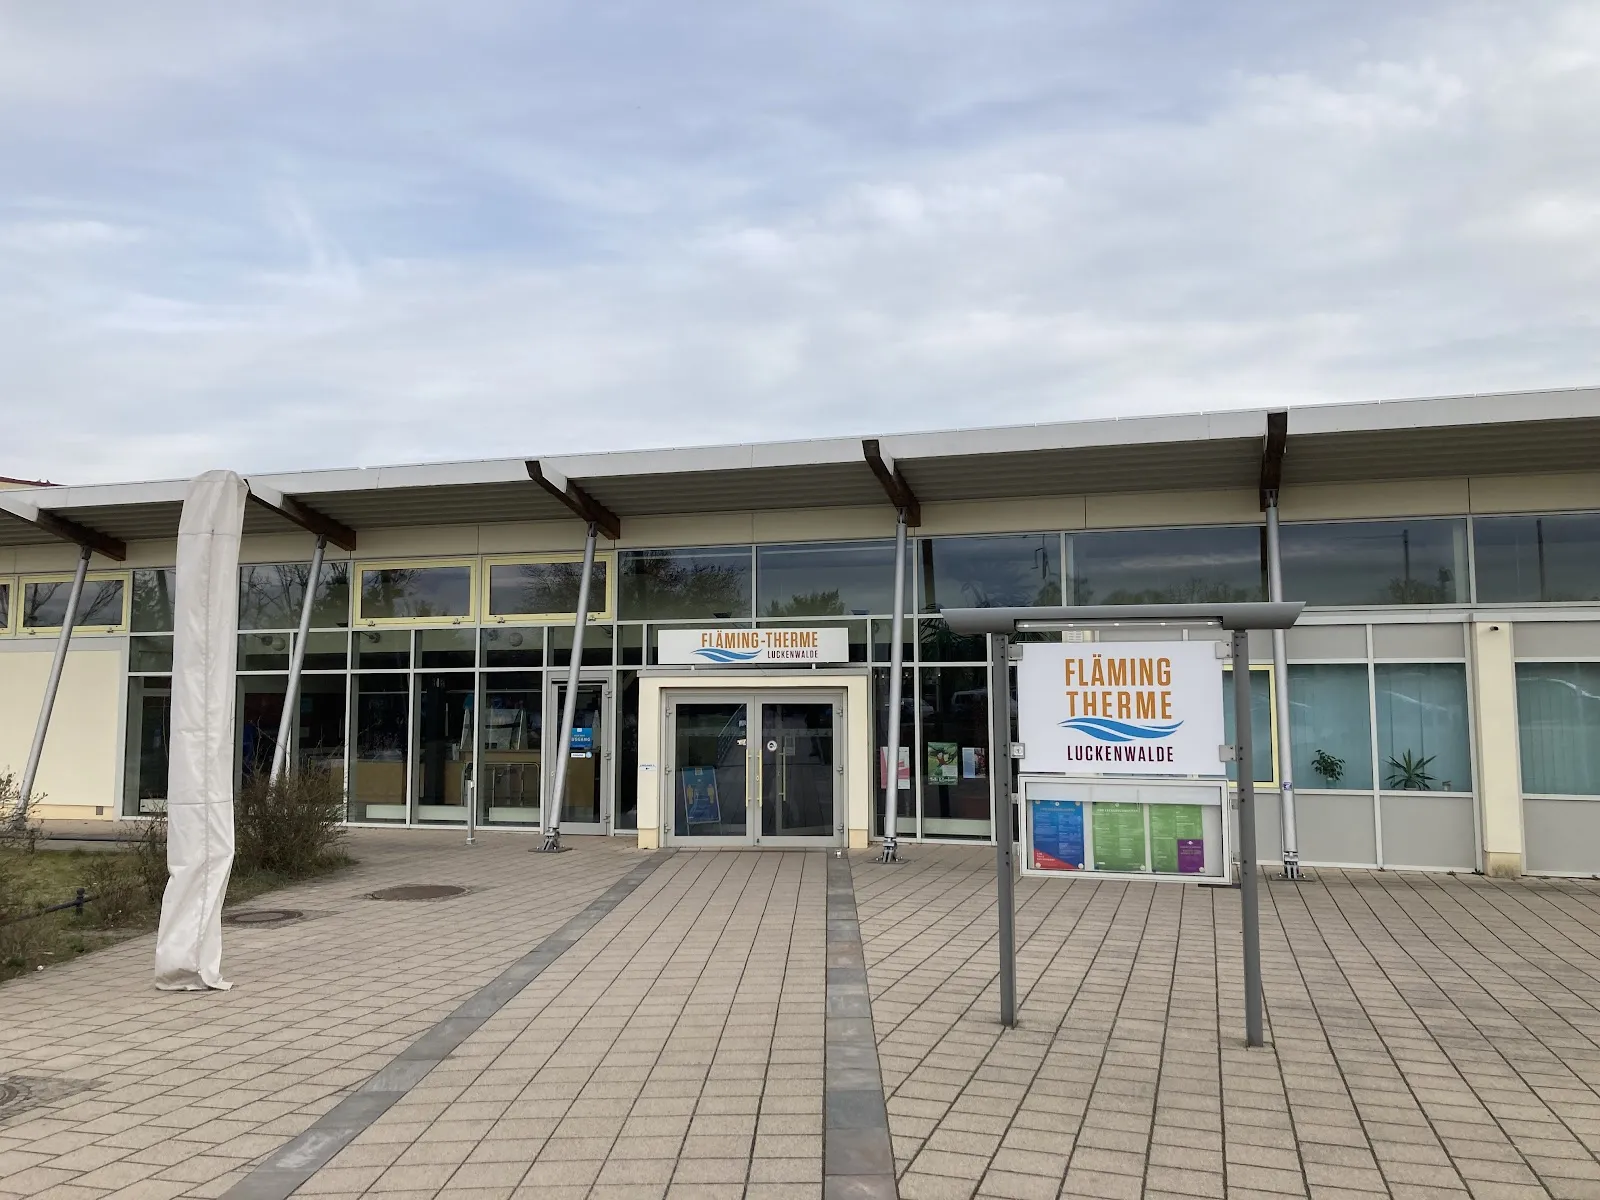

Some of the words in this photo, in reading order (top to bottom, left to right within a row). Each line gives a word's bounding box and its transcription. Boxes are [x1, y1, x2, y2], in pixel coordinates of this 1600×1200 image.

[701, 630, 818, 649] FLÄMING-THERME
[767, 649, 818, 659] LUCKENWALDE
[1065, 653, 1171, 687] FLÄMING
[1066, 691, 1172, 720] THERME
[1067, 745, 1174, 763] LUCKENWALDE
